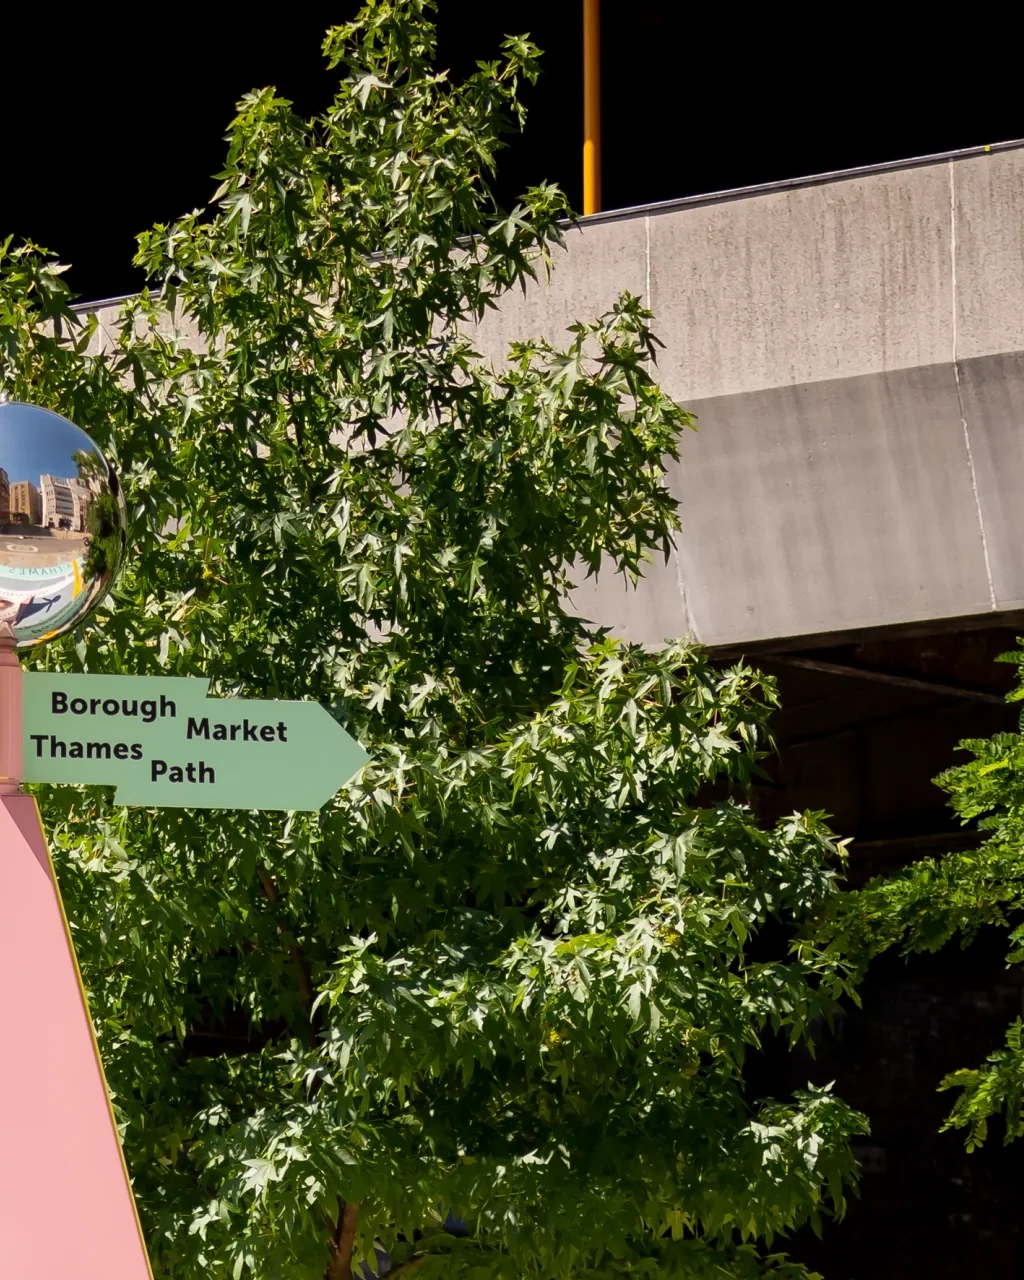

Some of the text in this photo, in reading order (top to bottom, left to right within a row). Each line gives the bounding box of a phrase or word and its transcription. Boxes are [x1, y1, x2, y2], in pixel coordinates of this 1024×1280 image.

[51, 691, 288, 742] Borough Market
[30, 734, 216, 783] Thames Path
